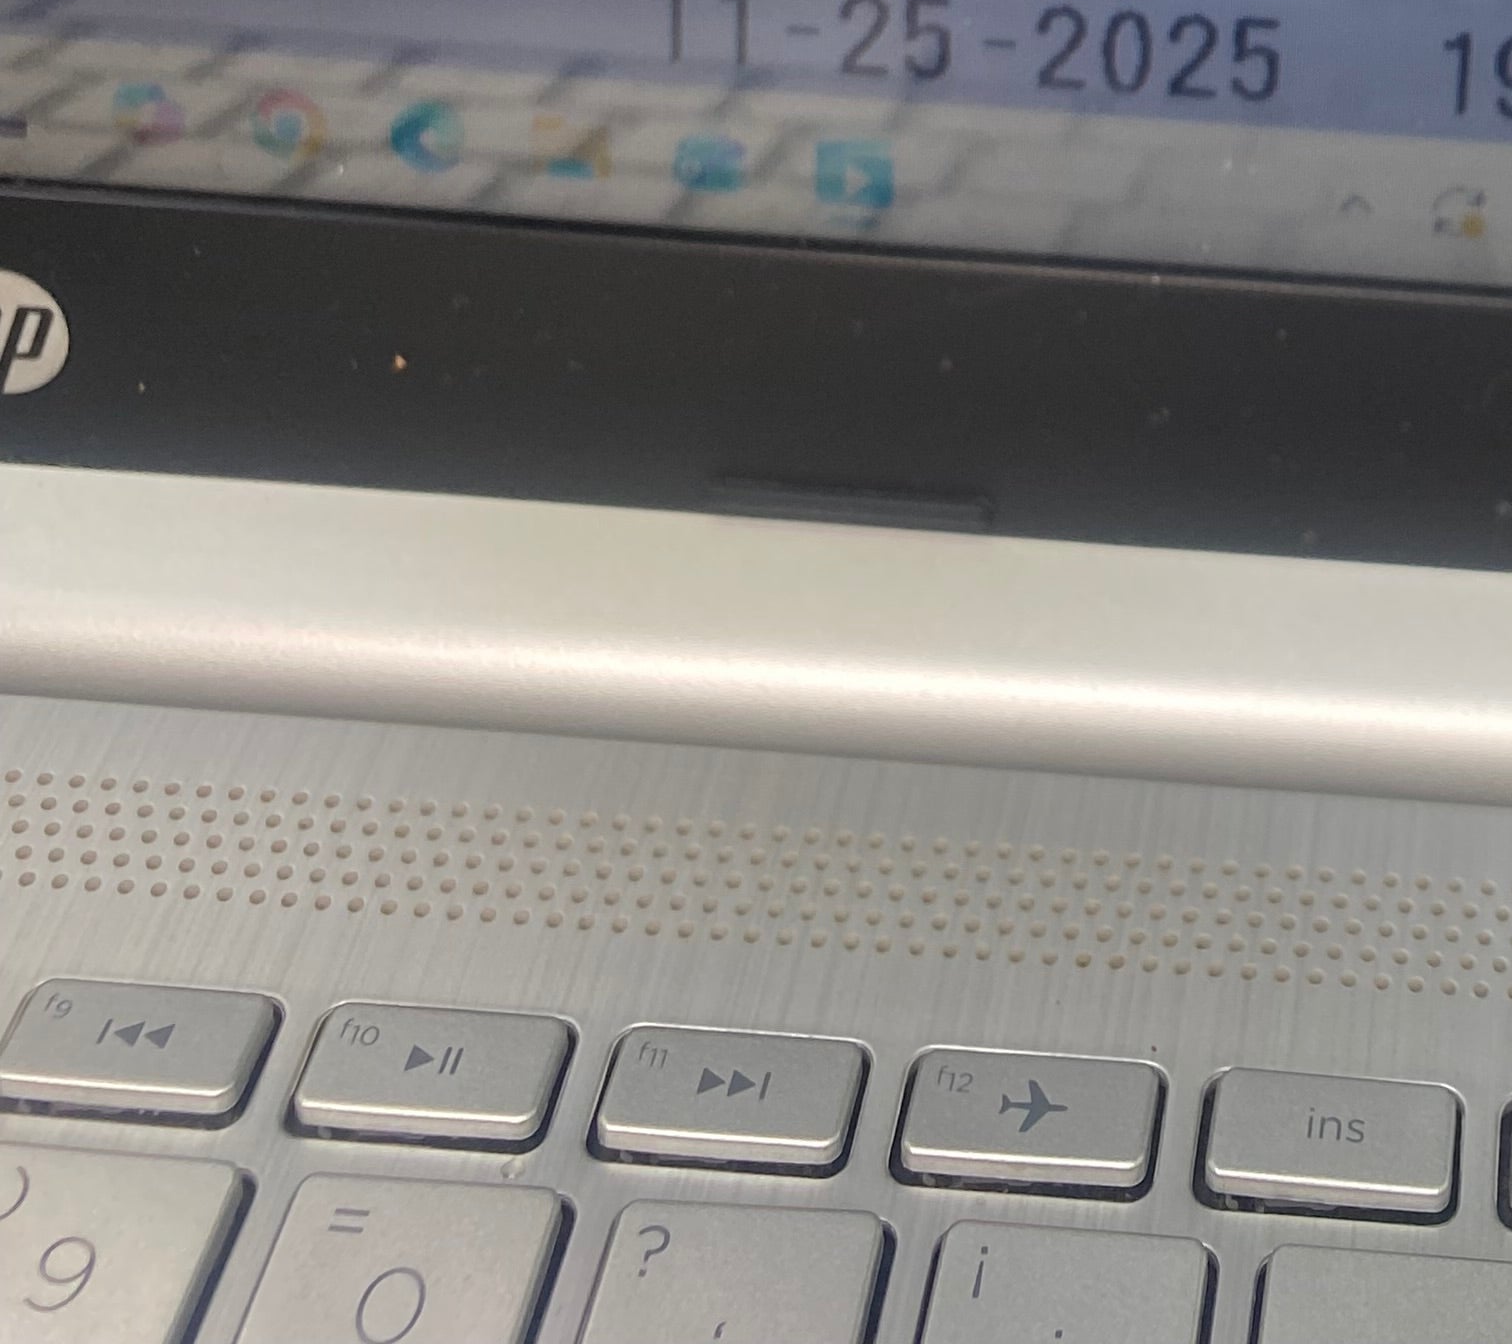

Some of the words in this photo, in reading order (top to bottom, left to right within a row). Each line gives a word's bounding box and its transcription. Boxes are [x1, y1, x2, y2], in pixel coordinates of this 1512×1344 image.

[0, 306, 54, 395] p
[42, 992, 74, 1019] f9
[339, 1016, 382, 1047] f10
[637, 1040, 669, 1069] f11
[935, 1064, 975, 1094] f12
[1304, 1106, 1366, 1145] ins
[636, 1224, 672, 1279] ?
[23, 1235, 97, 1311] 9
